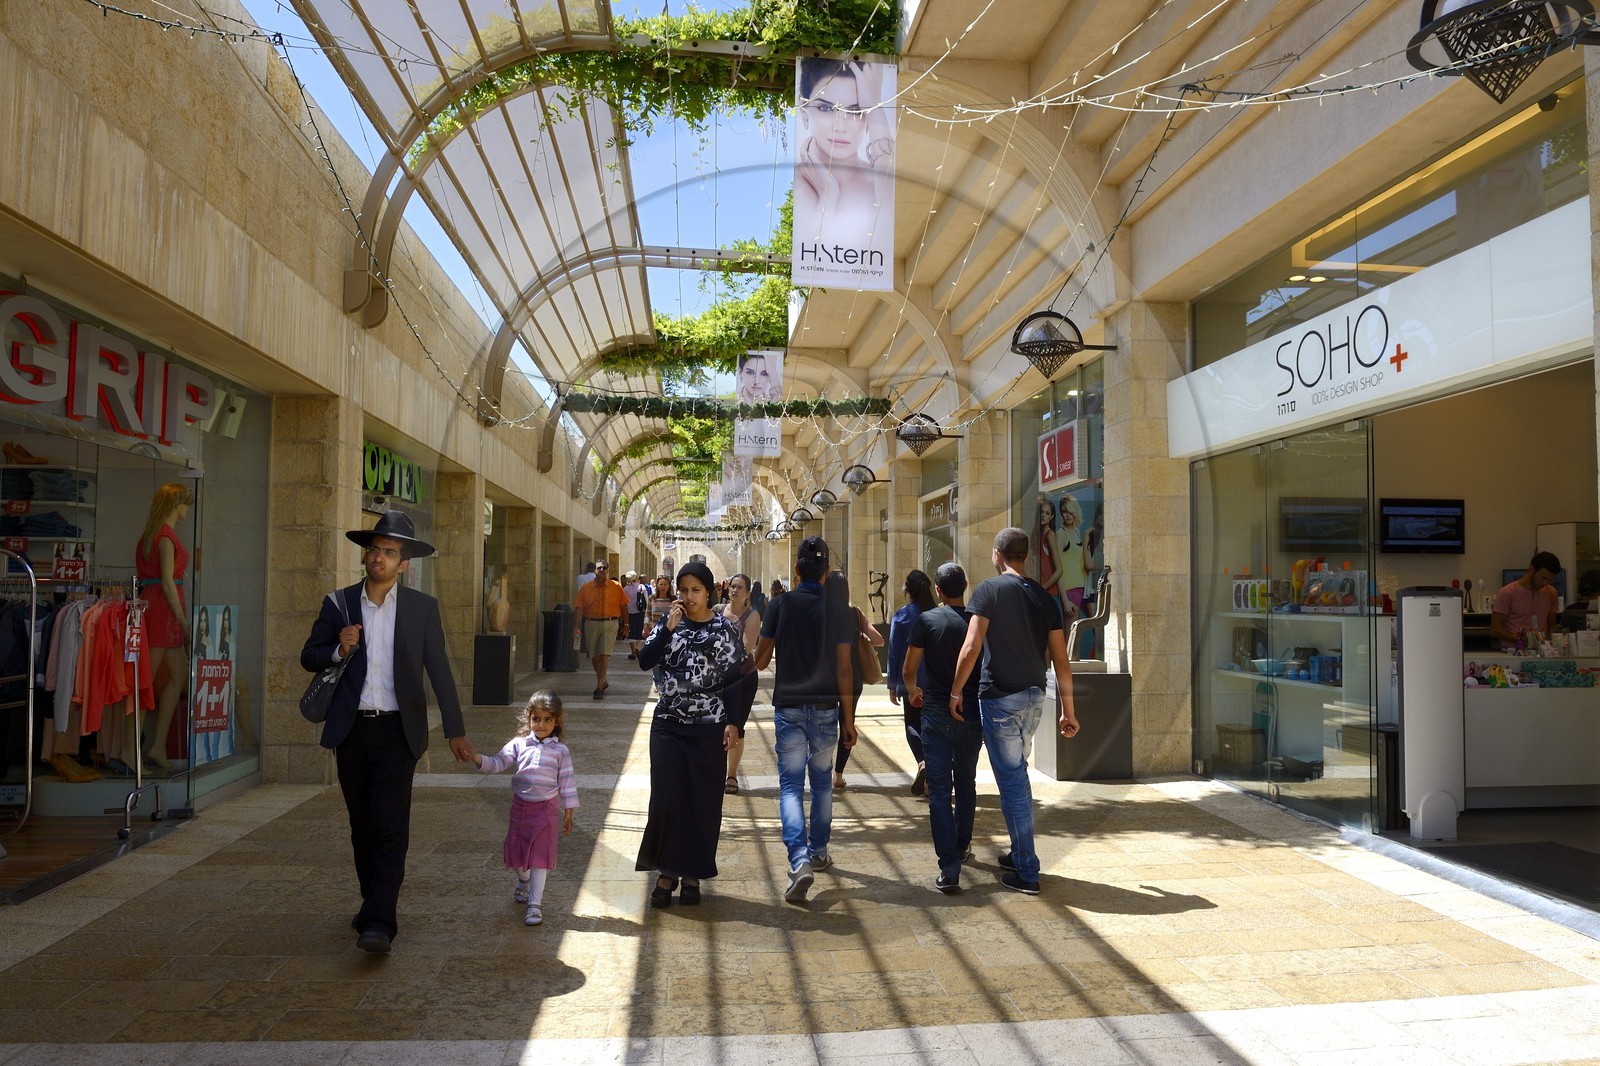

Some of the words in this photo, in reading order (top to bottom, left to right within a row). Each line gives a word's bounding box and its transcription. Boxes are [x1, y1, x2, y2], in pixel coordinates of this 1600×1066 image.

[0, 290, 215, 446] GRIP
[1311, 391, 1329, 405] 100%
[1330, 380, 1359, 400] DESIGN
[1360, 371, 1384, 391] SHOP
[1277, 400, 1296, 416] סוהו
[56, 566, 85, 580] 1+1
[201, 665, 221, 678] החנות
[222, 662, 229, 678] כל
[196, 680, 230, 717] 1+1
